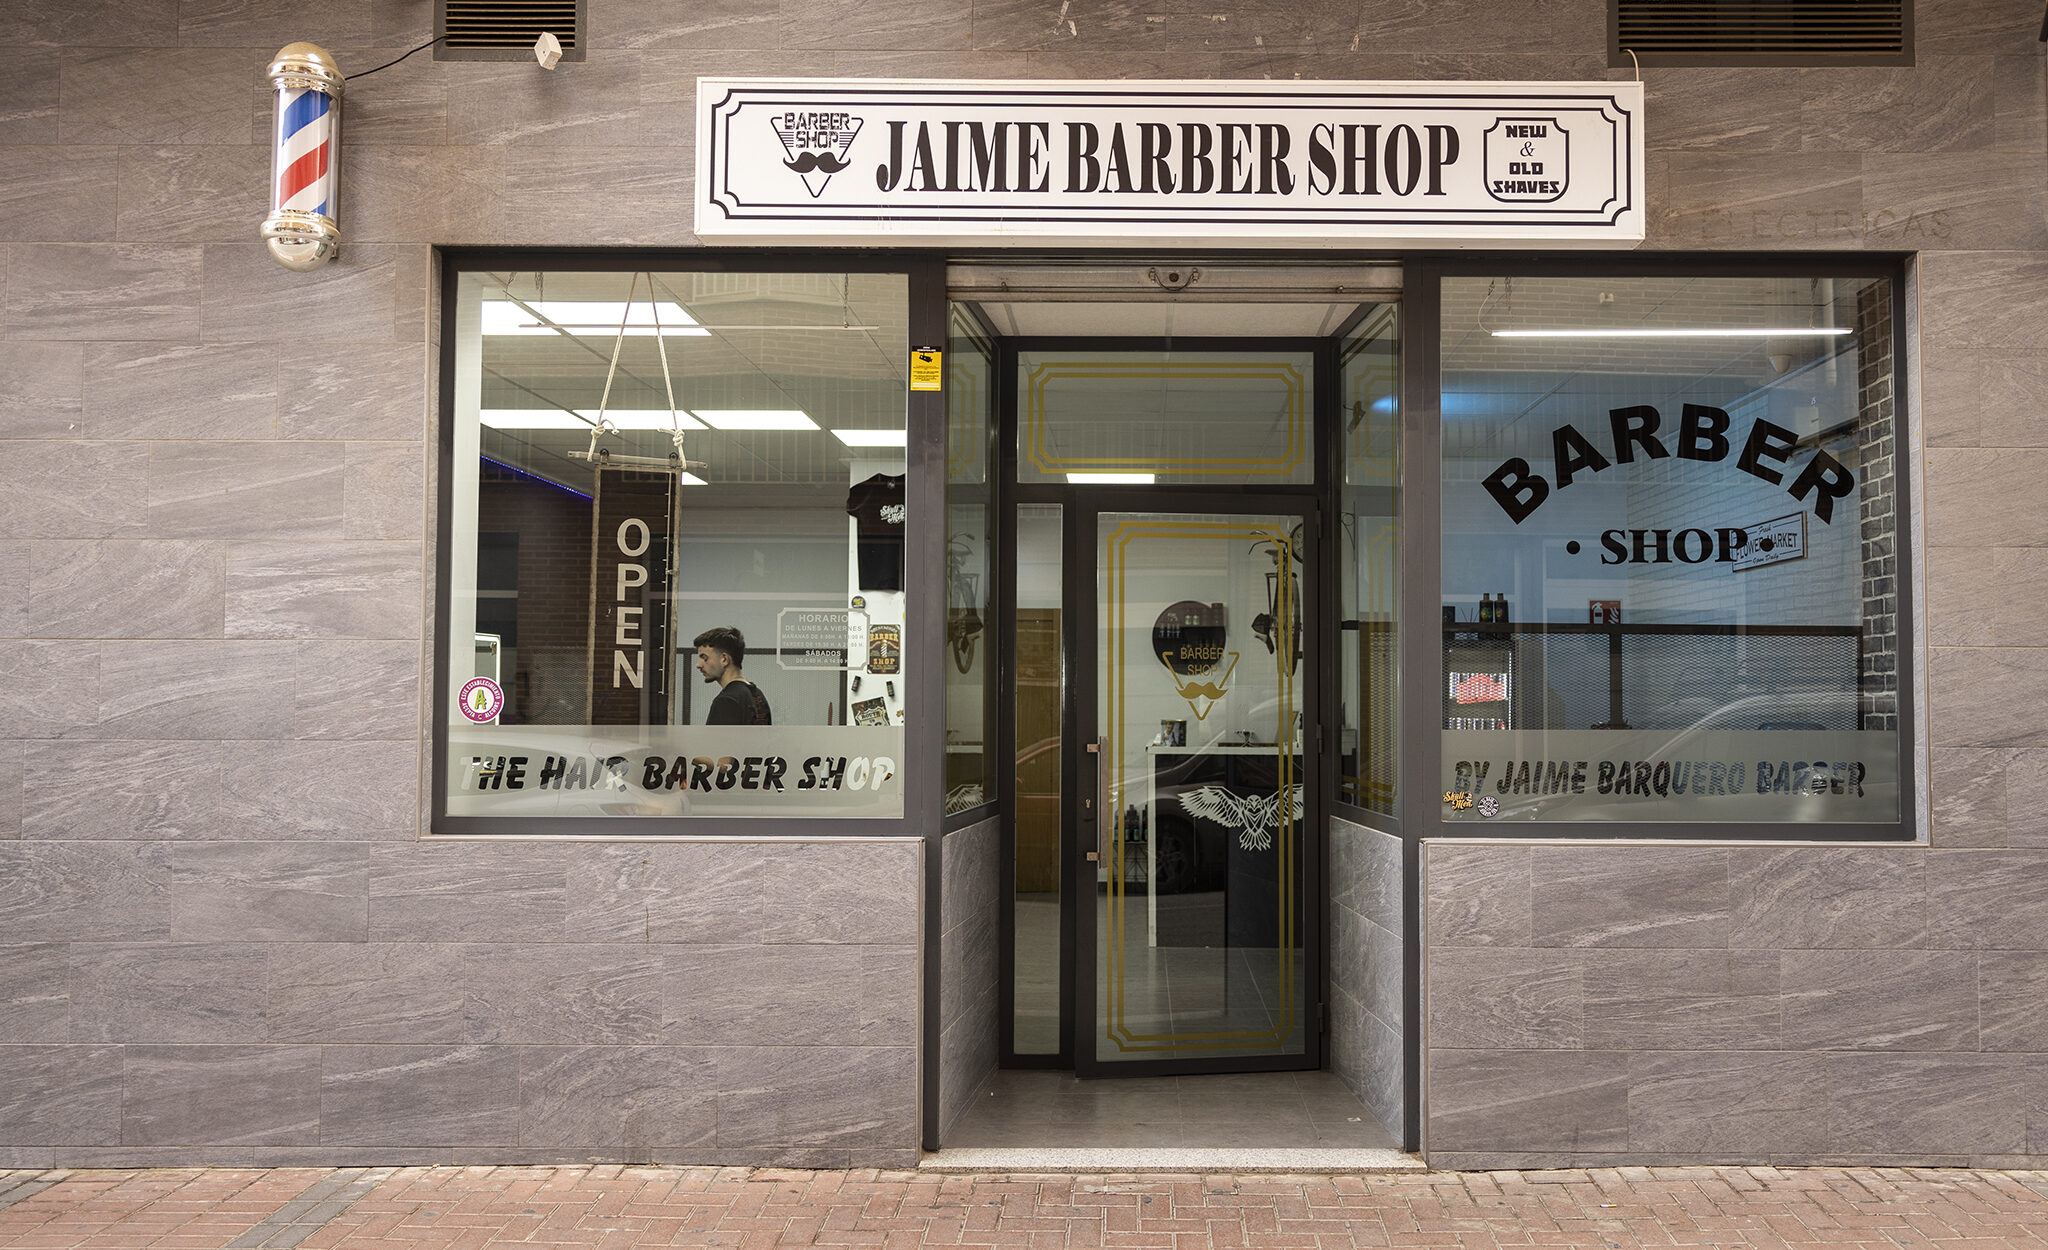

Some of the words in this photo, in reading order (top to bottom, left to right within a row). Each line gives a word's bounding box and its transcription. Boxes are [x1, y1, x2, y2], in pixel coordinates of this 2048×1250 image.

[784, 112, 850, 130] BARBER
[796, 131, 838, 148] SHOP
[1505, 125, 1547, 138] NEW
[1520, 141, 1535, 157] &
[876, 121, 1049, 192] JAIME
[1063, 122, 1296, 195] BARBER
[1308, 123, 1460, 196] SHOP
[1509, 162, 1544, 175] OLD
[1493, 180, 1560, 193] SHAVES
[1481, 403, 1855, 526] BARBER
[1600, 528, 1748, 565] SHOP
[613, 518, 650, 689] OPEN
[798, 614, 848, 623] HORARIO
[805, 649, 841, 657] SÁBADOS
[1180, 648, 1225, 660] BARBER
[1187, 664, 1218, 676] SHOP
[460, 756, 529, 790] THE
[540, 756, 630, 792] HAIR
[641, 756, 788, 793] BARBER
[798, 756, 896, 791] SHOP
[1454, 761, 1490, 794] BY
[1497, 761, 1588, 795] JAIME
[1597, 761, 1745, 798] BARQUERO
[1756, 761, 1866, 798] BARBER
